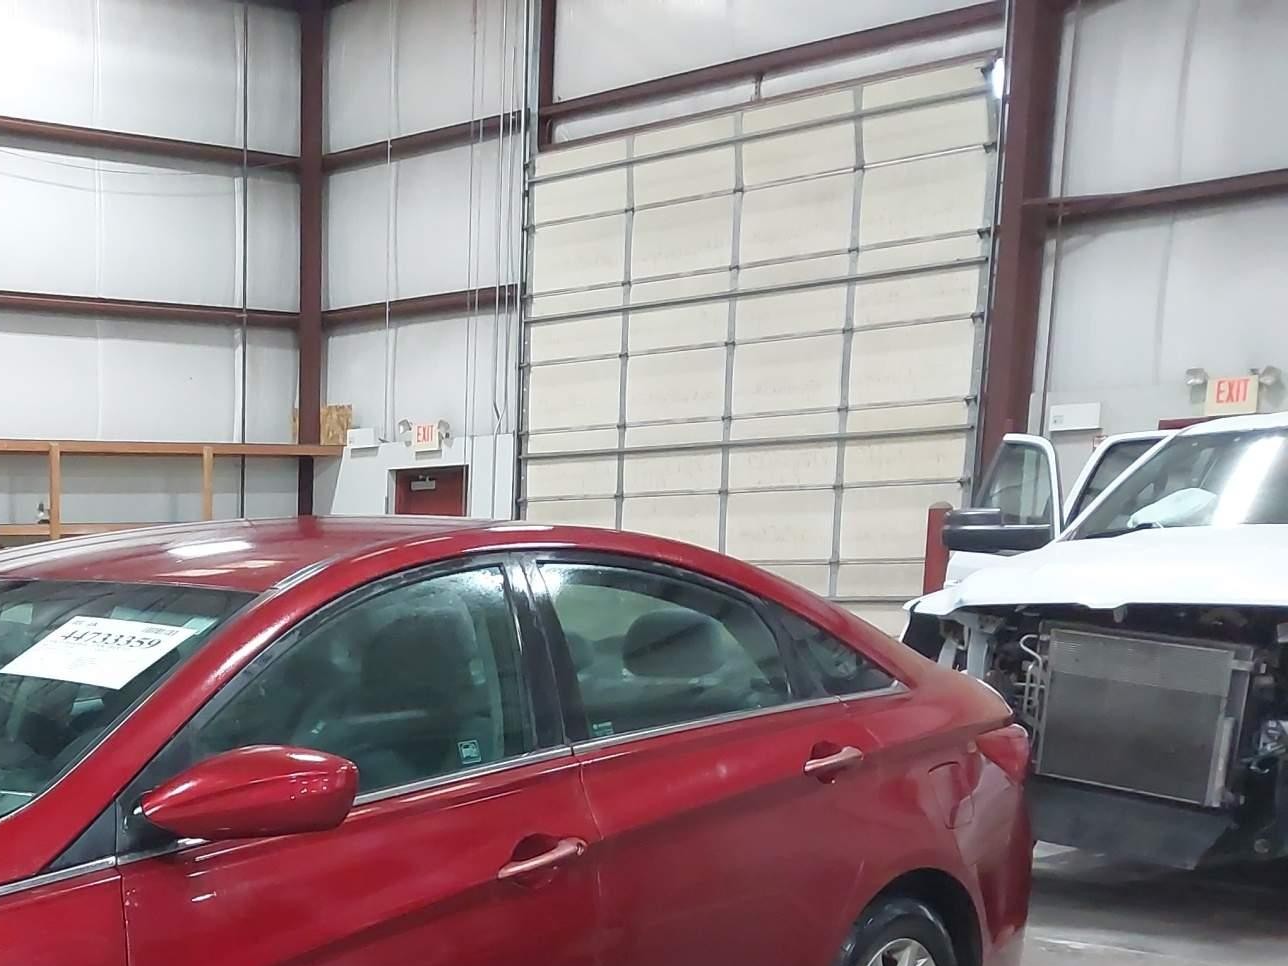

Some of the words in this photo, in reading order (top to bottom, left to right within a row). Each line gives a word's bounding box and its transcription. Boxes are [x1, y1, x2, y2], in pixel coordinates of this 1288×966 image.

[1215, 378, 1250, 404] EXIT
[416, 424, 434, 443] EXIT
[60, 630, 161, 649] 44733359
